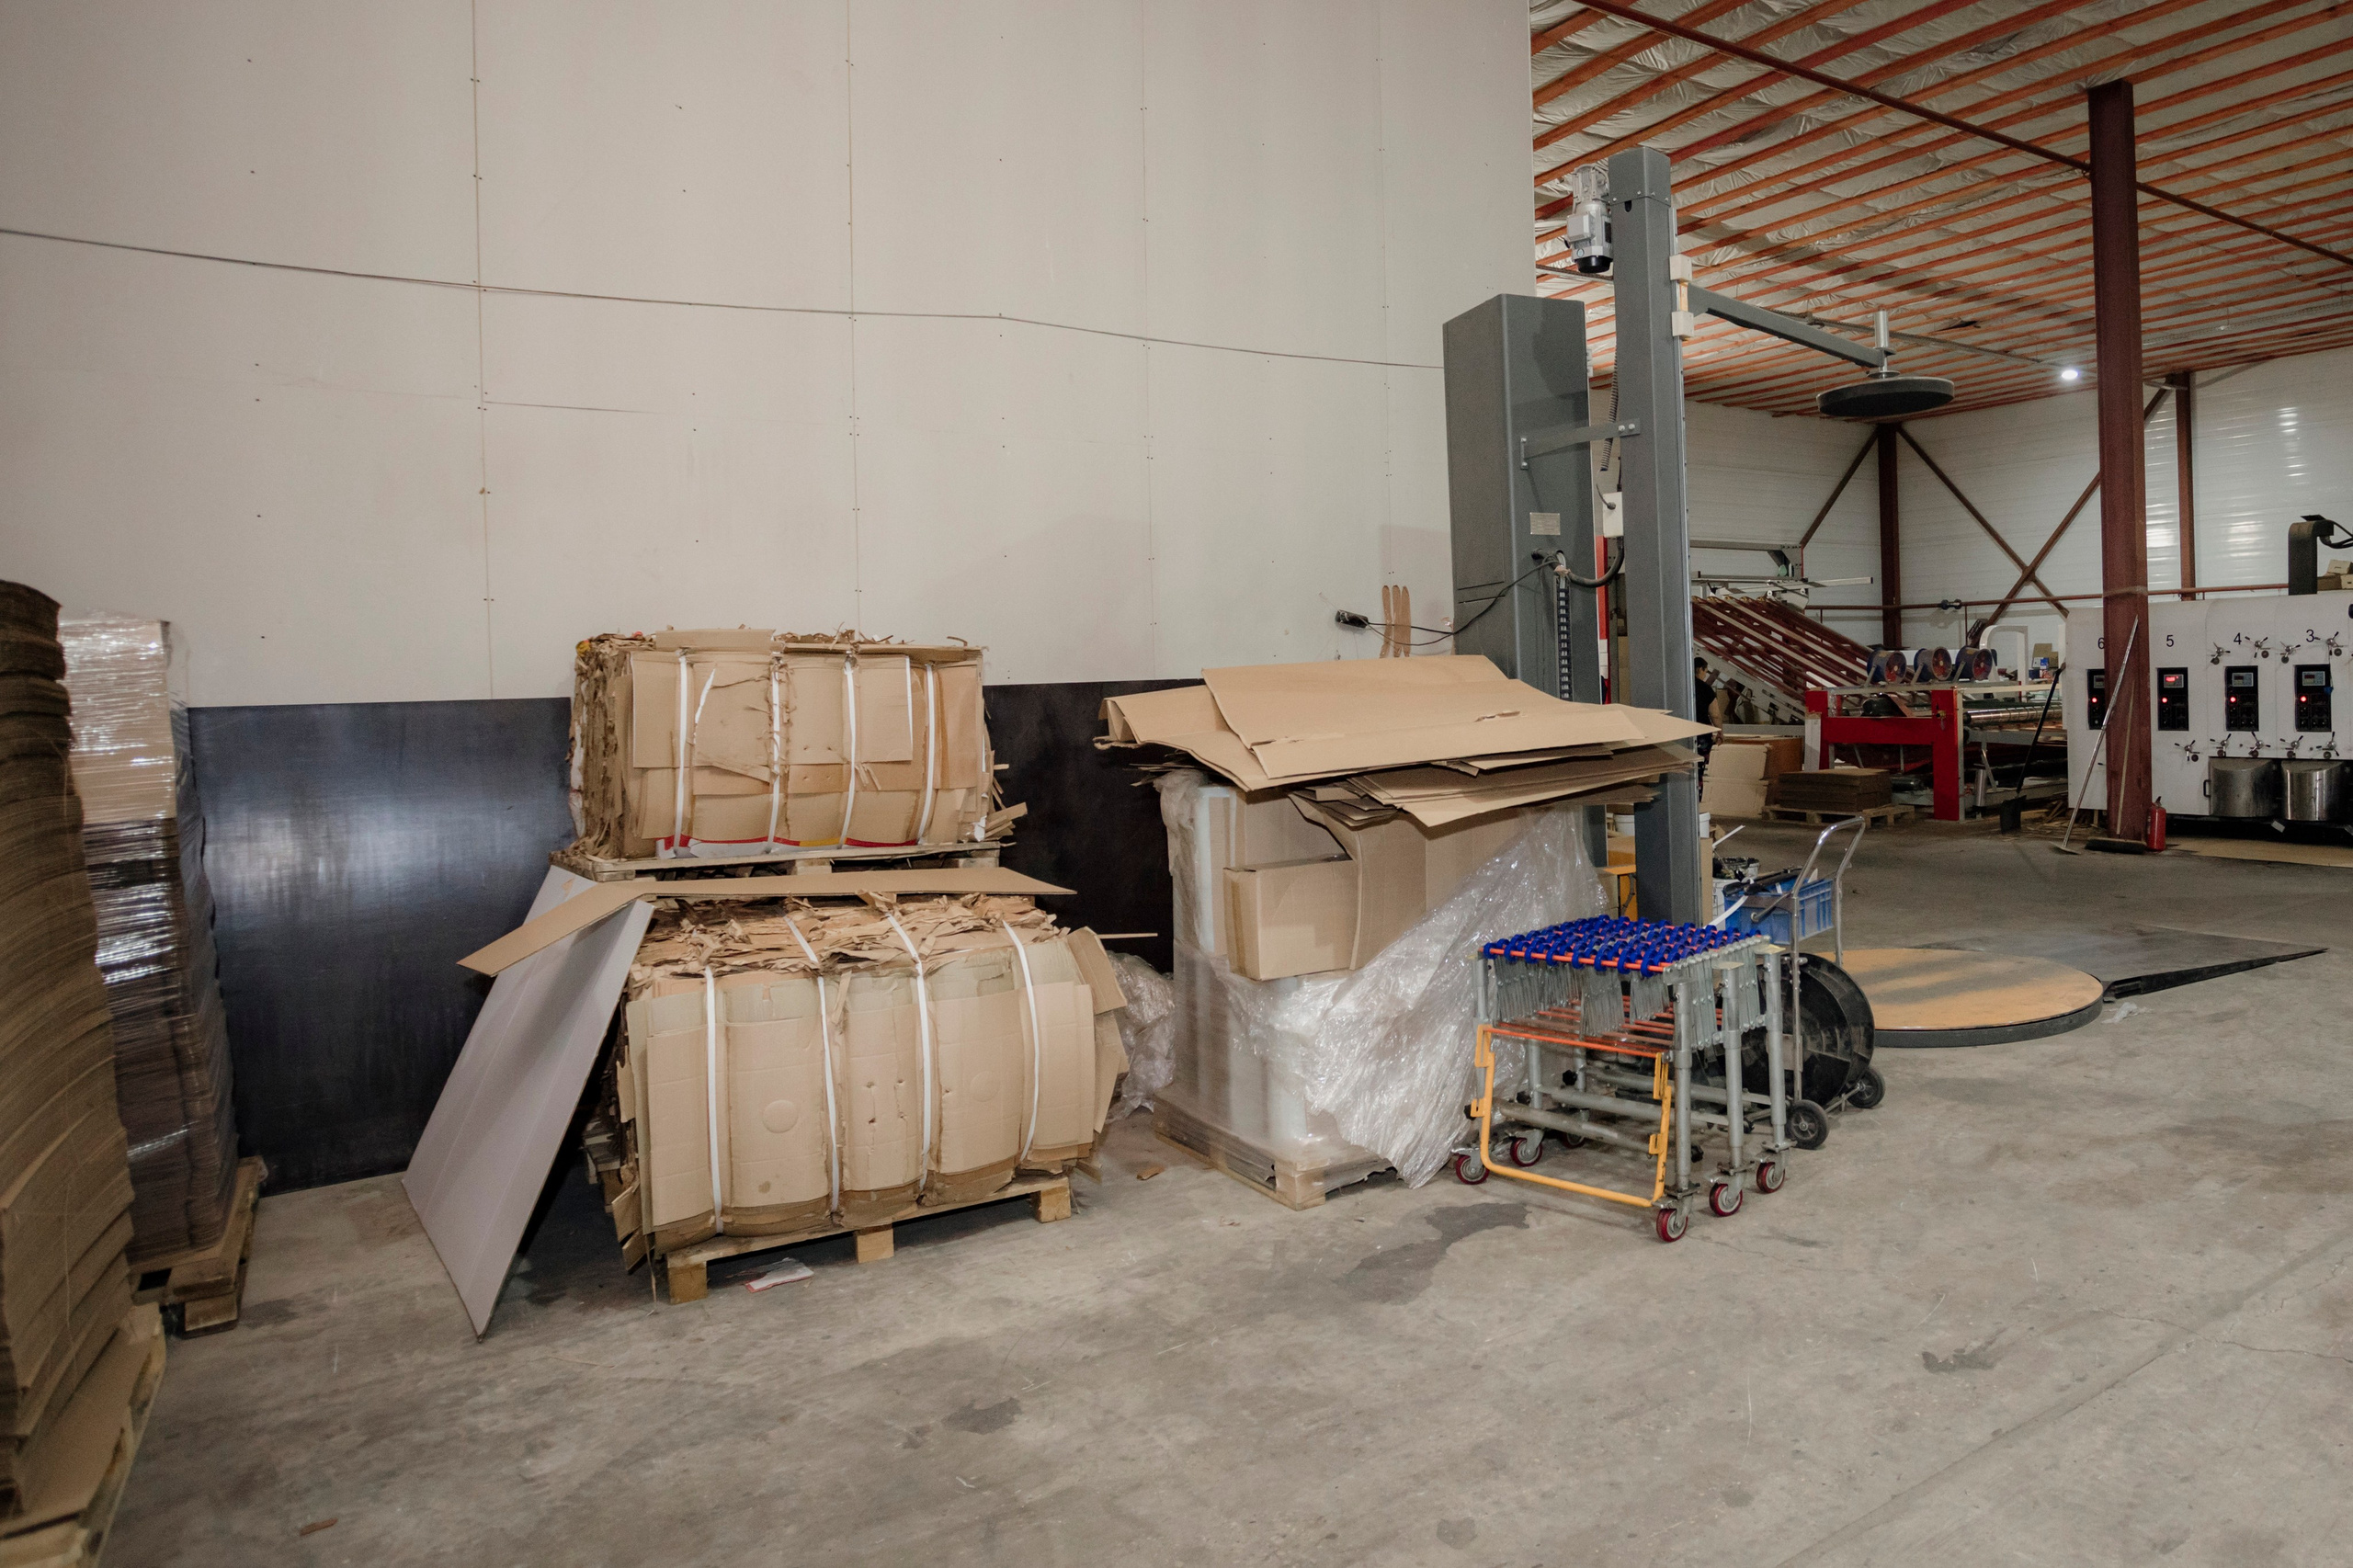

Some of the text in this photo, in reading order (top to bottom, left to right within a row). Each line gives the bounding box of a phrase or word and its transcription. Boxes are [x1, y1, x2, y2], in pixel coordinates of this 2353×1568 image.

[2165, 634, 2175, 647] 5
[2234, 632, 2242, 645] 4
[2305, 629, 2314, 642] 3
[2097, 637, 2105, 649] 6
